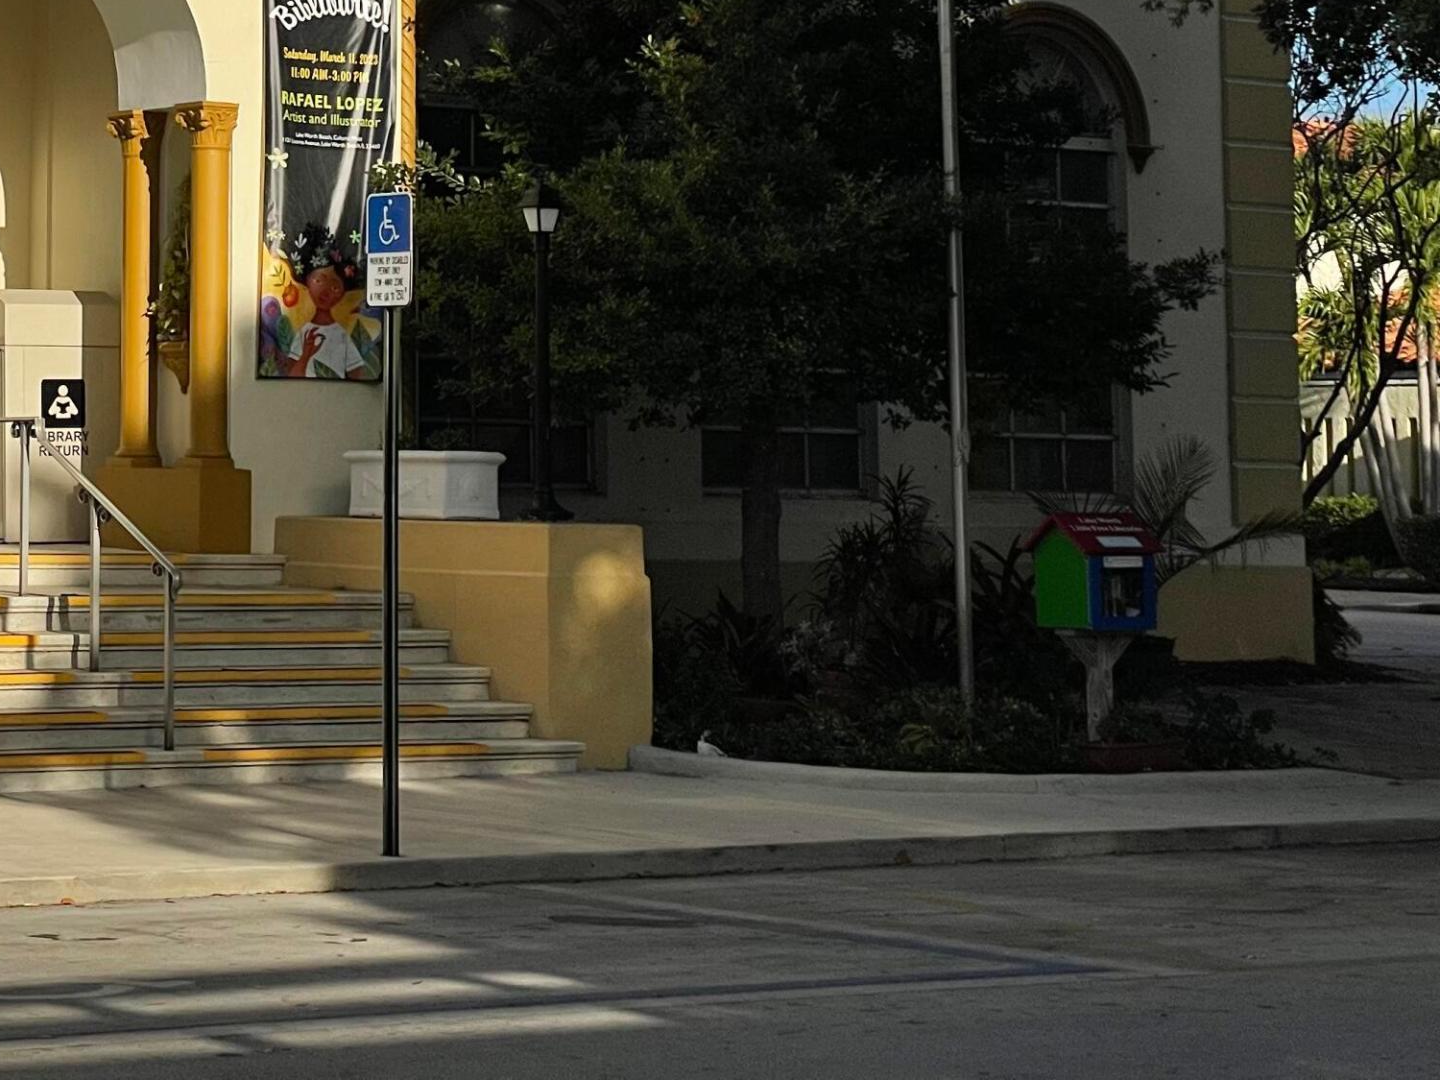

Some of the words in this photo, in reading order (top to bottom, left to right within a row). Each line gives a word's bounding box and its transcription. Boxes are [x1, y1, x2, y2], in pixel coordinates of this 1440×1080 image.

[320, 50, 346, 63] March
[359, 53, 379, 66] 2023
[291, 66, 311, 79] 11:00
[281, 90, 332, 110] RAFAEL
[336, 96, 384, 112] LOPEZ
[283, 109, 307, 123] Artist
[308, 113, 328, 125] and
[330, 114, 381, 128] Illustrator
[46, 431, 90, 442] BRARY
[39, 444, 89, 457] RTURN
